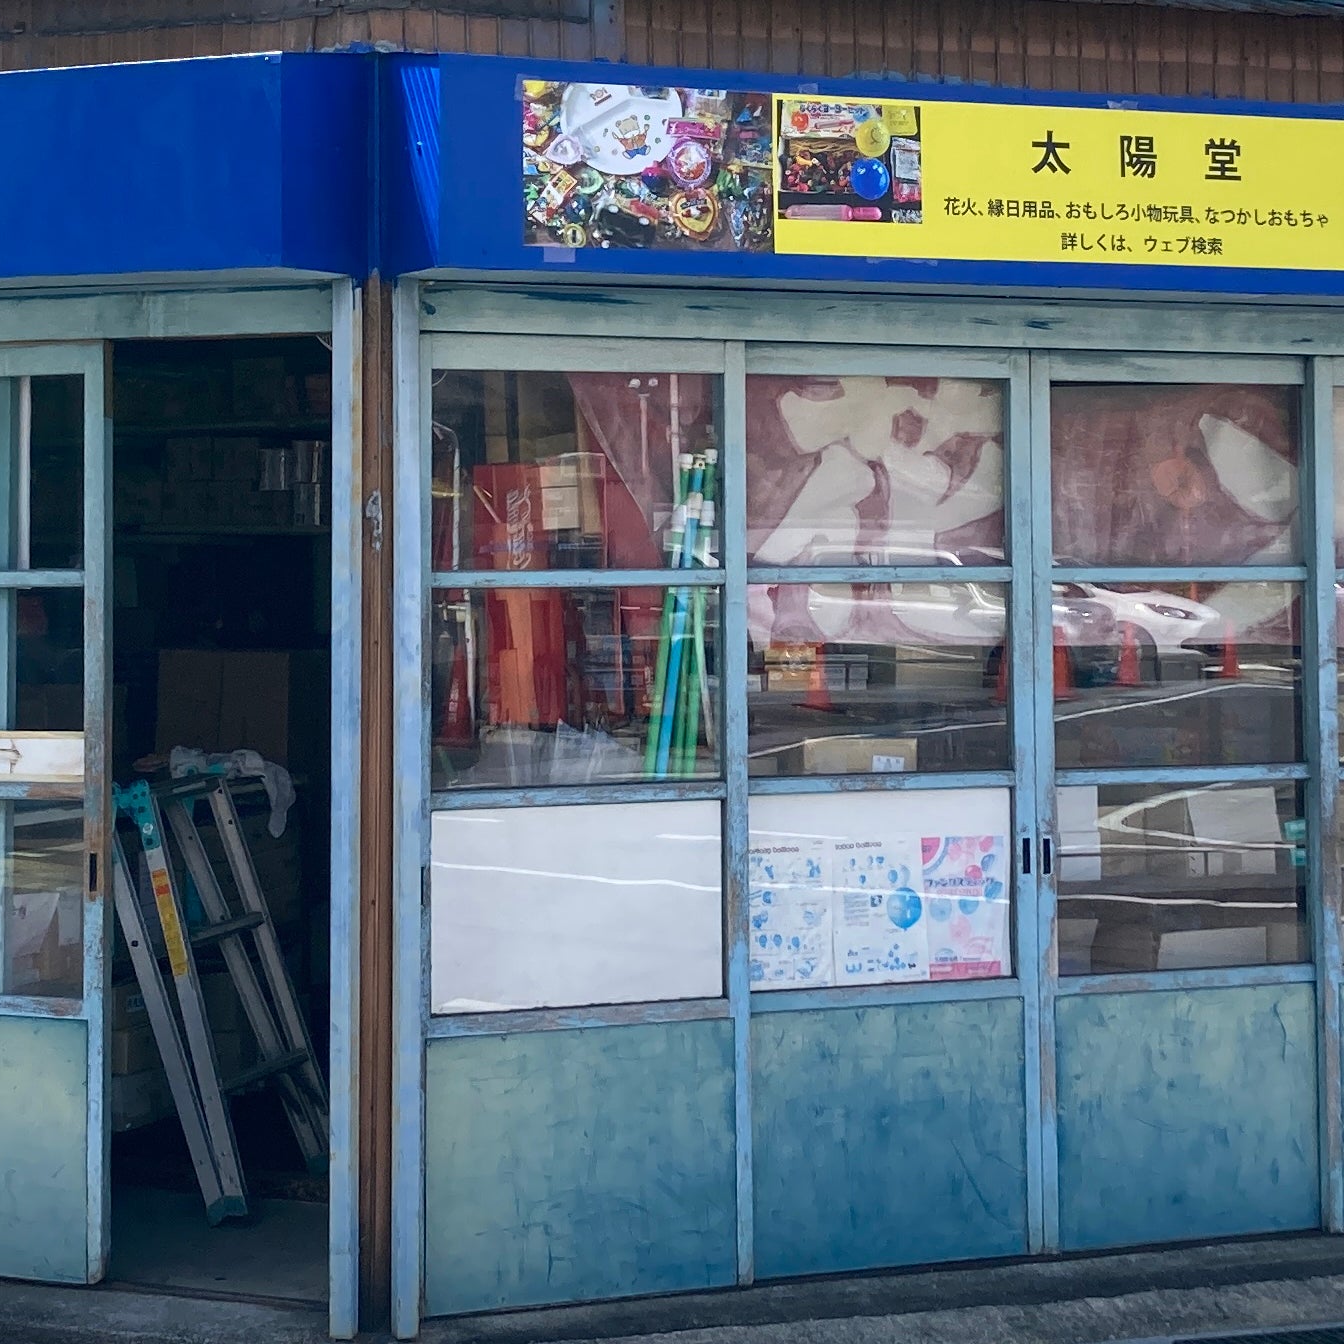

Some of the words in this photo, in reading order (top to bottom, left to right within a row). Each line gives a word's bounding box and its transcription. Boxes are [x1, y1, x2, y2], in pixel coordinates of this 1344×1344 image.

[1031, 130, 1242, 181] 太陽堂
[1061, 232, 1223, 256] 詳しくは、ウェブ検索
